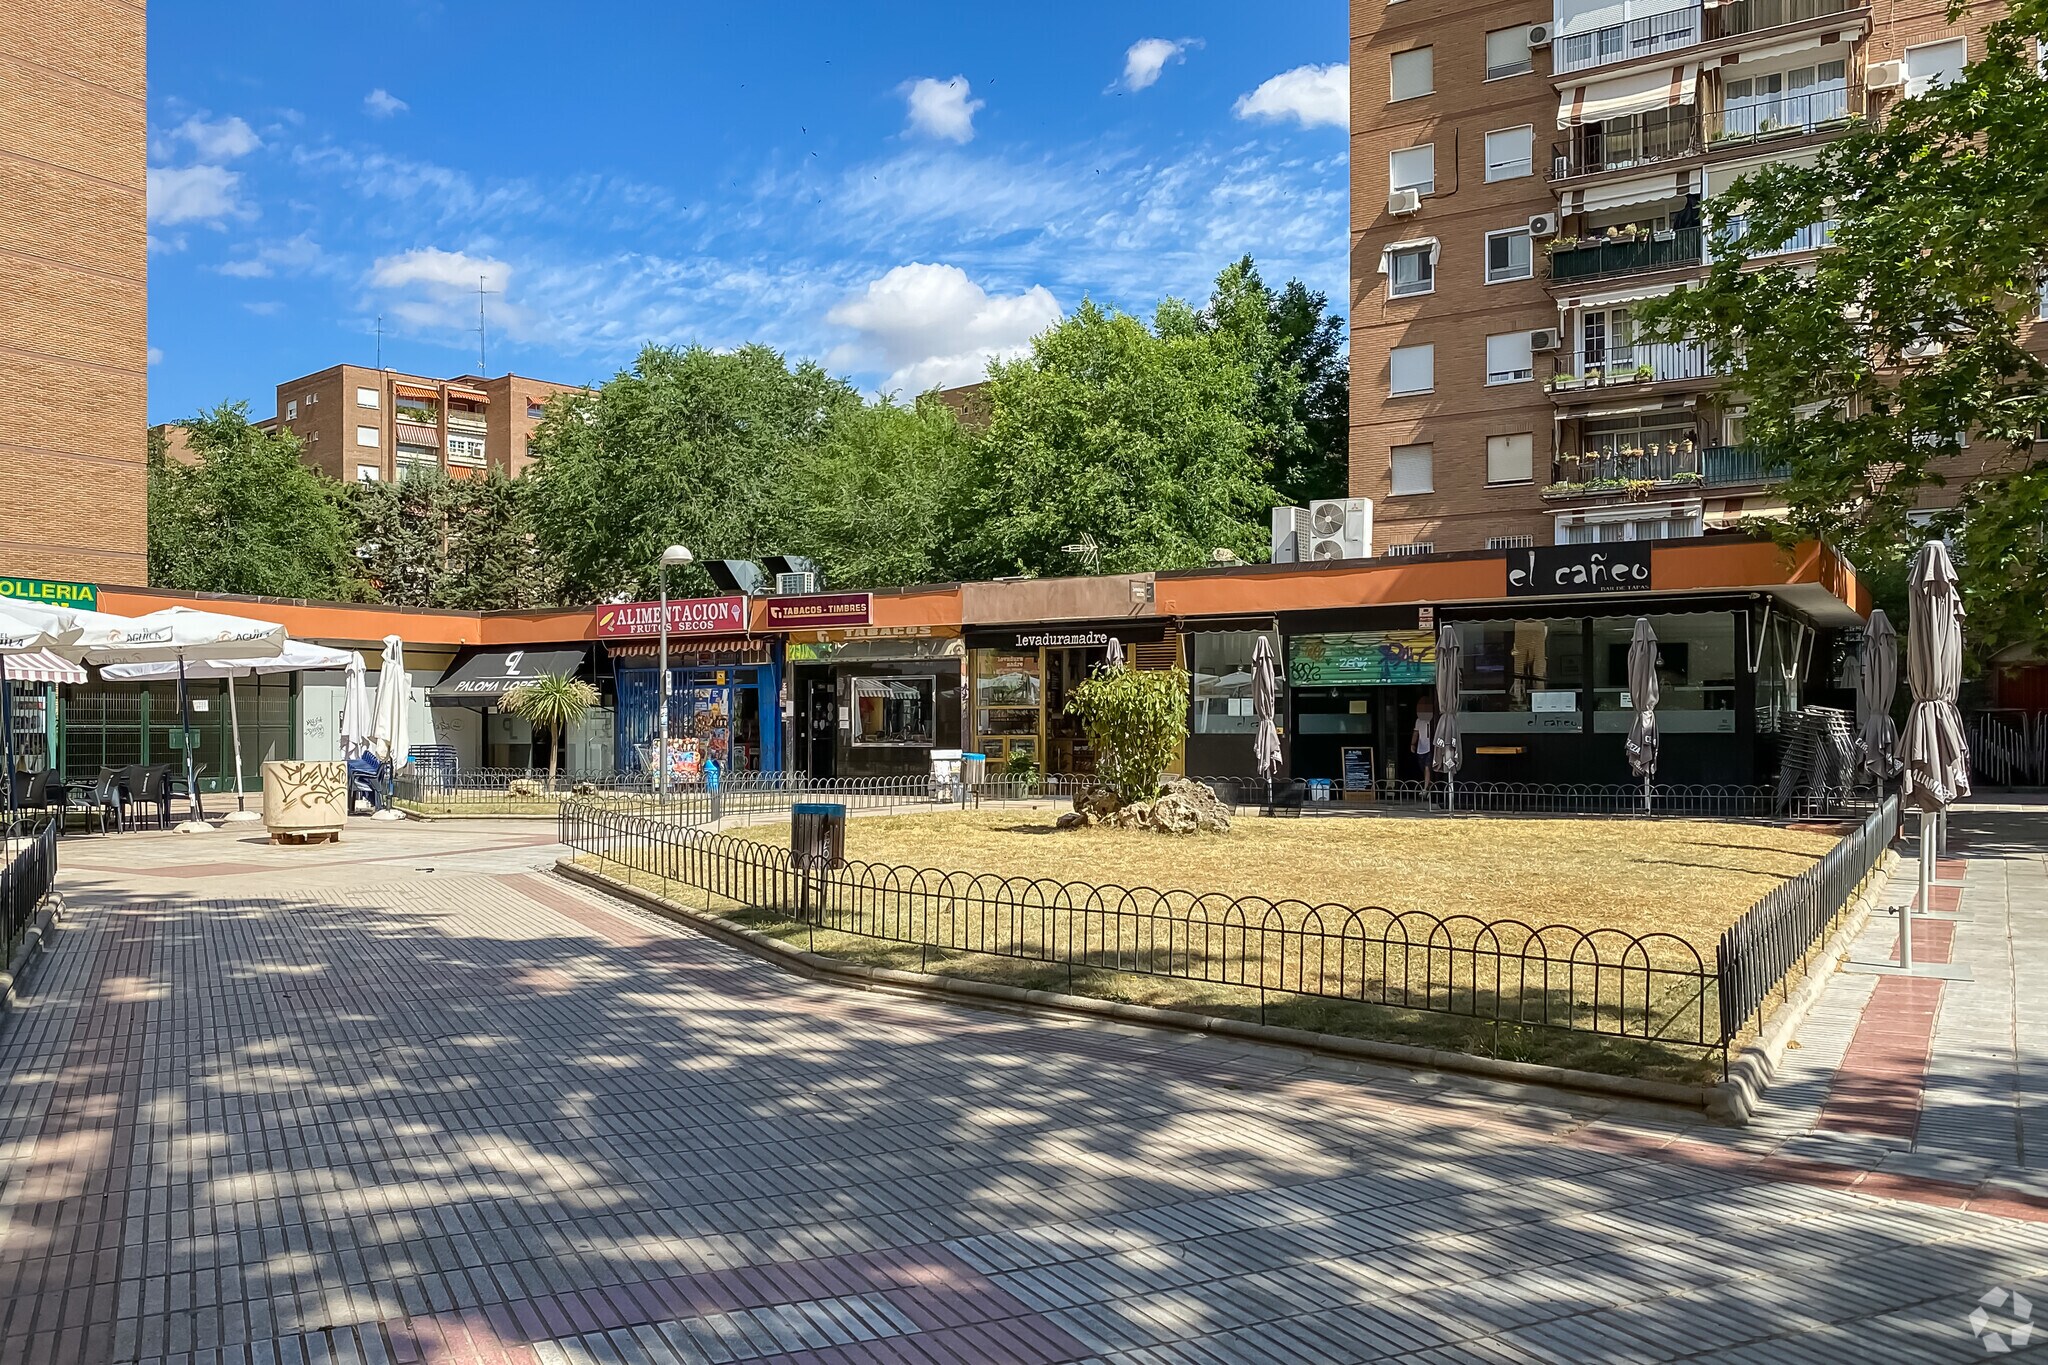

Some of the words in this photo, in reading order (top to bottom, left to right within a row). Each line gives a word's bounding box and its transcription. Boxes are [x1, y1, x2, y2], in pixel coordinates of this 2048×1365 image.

[1509, 550, 1535, 587] el
[1555, 553, 1648, 585] cañeo
[617, 602, 729, 626] ALIMENTACION
[783, 605, 822, 616] TABACOS
[828, 603, 867, 613] TIMBRES
[679, 620, 714, 631] SECOS
[844, 625, 932, 637] TABACOS
[1015, 631, 1108, 647] levaduramadre
[455, 681, 500, 692] PALOMA
